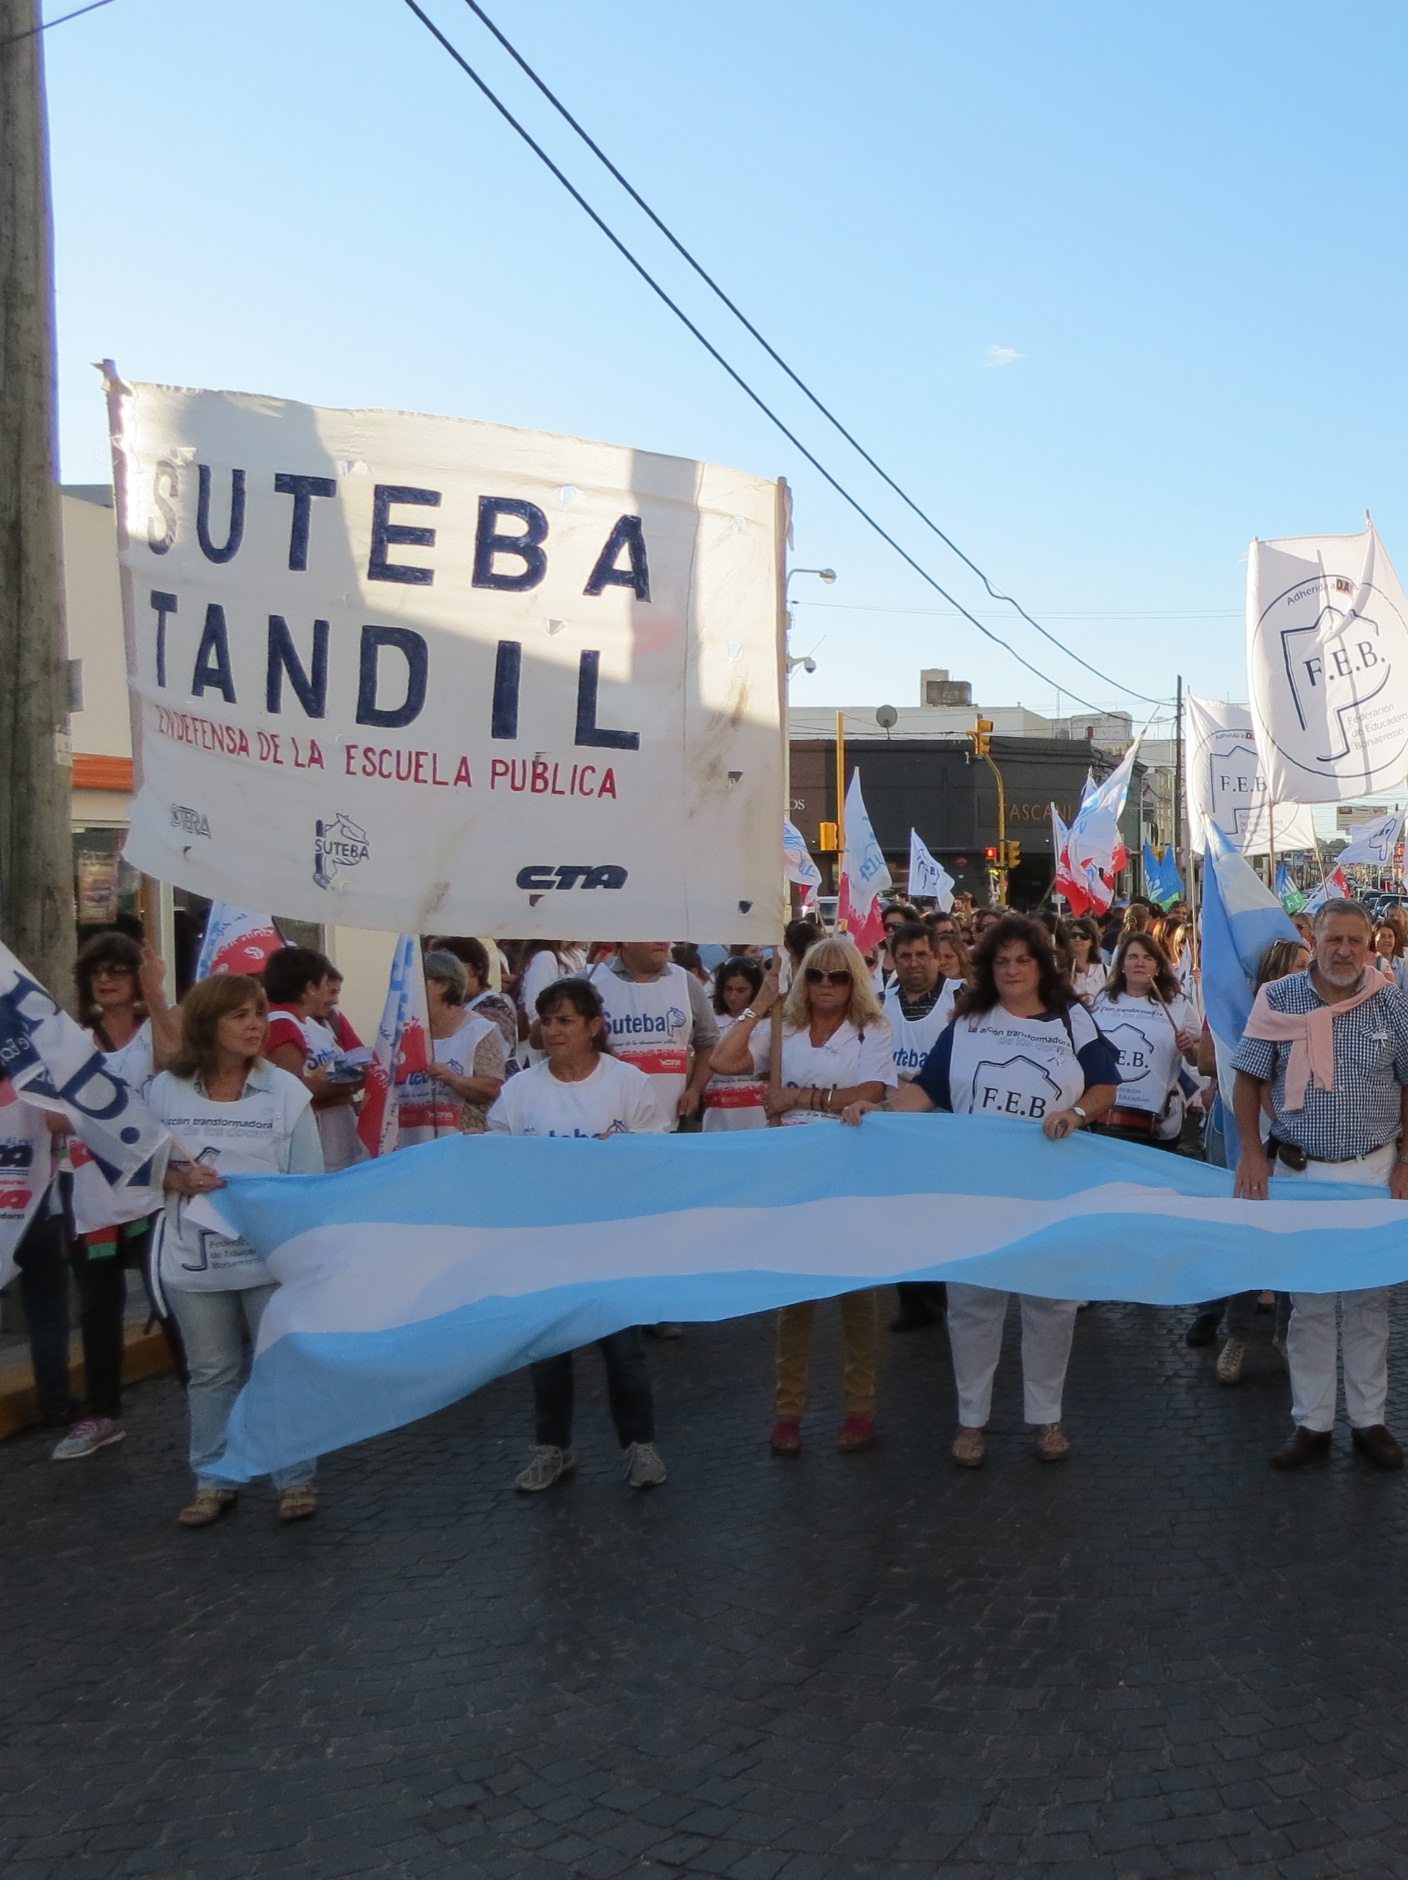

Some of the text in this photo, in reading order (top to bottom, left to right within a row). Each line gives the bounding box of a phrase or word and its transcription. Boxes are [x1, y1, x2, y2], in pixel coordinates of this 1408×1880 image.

[147, 459, 653, 604] SUTEBA
[150, 589, 641, 752] TANDIL
[1302, 640, 1386, 687] F.E.B.
[1364, 712, 1408, 733] Educadores
[1353, 727, 1406, 751] Bonaerenses
[257, 731, 285, 765] DE
[291, 736, 325, 770] LA
[345, 744, 473, 788] ESCUELA
[1000, 803, 1072, 821] ASCANI
[315, 838, 370, 860] SUTEBA
[516, 865, 629, 890] CTA
